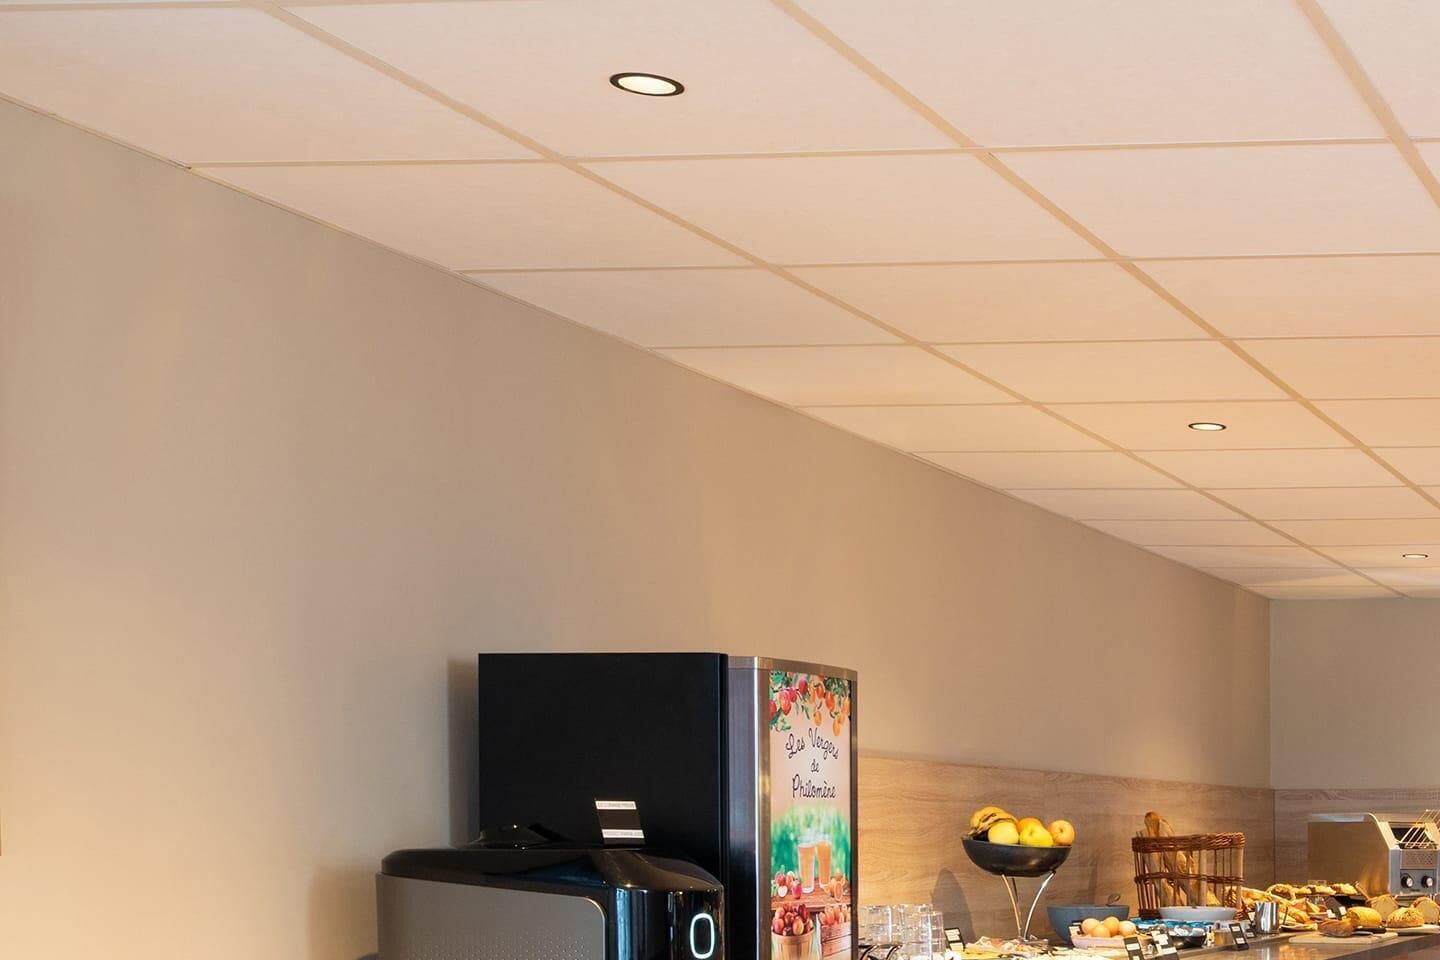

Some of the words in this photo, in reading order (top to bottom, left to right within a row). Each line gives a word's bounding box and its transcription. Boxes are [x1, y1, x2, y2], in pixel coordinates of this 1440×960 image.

[785, 733, 806, 759] Les
[808, 727, 839, 760] Vergers
[810, 759, 820, 773] de
[792, 773, 836, 798] Philomène
